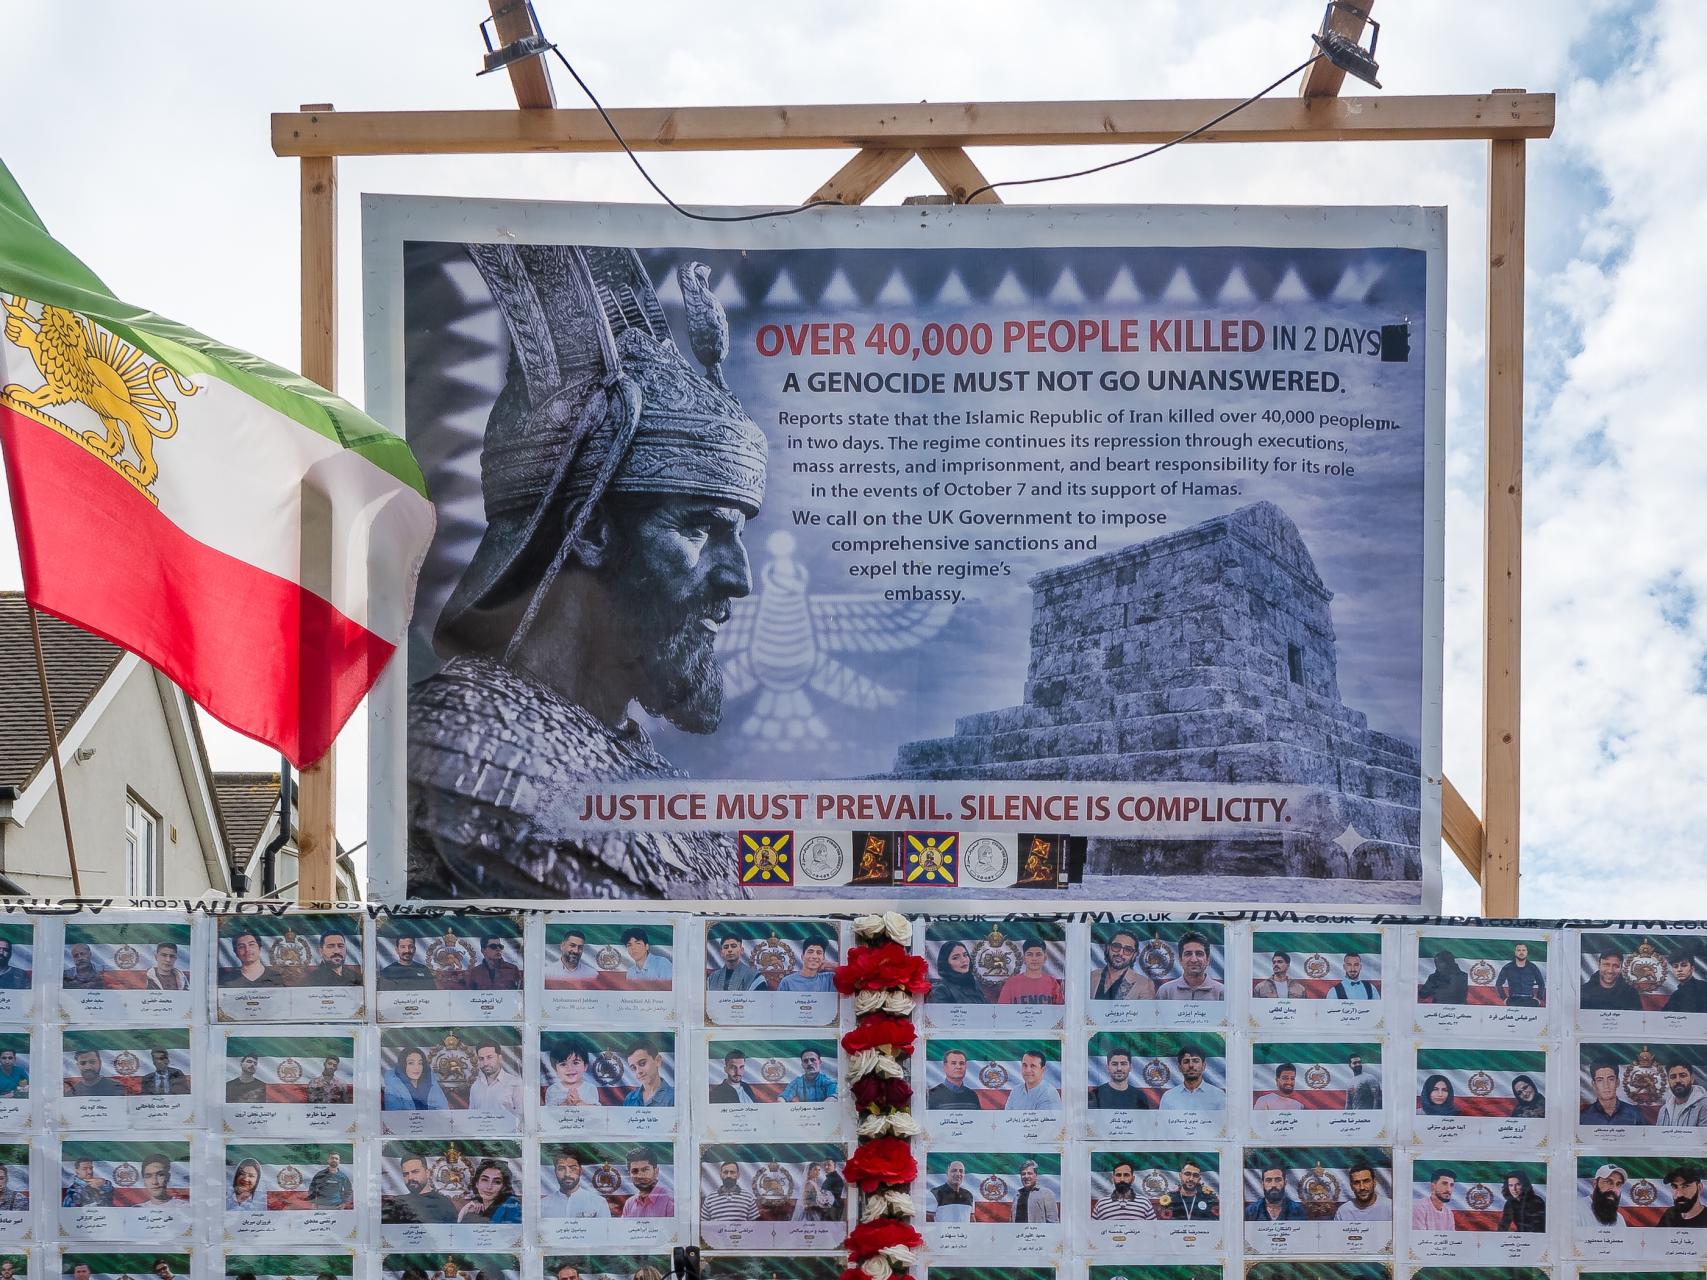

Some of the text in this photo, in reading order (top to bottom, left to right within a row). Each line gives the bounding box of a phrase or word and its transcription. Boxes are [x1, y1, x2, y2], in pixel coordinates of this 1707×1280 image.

[755, 323, 855, 357] OVER
[864, 322, 992, 361] 40,000
[1003, 319, 1140, 353] PEOPLE
[1150, 319, 1265, 353] KILLED
[1272, 325, 1296, 351] IN
[1304, 325, 1316, 352] 2
[782, 370, 1346, 393] A GENOCIDE MUST NOT GO UNANSWERED.
[779, 411, 843, 429] Reports
[848, 413, 889, 426] state
[894, 411, 929, 426] that
[933, 412, 961, 426] the
[966, 409, 1024, 425] Islamic
[1030, 409, 1102, 427] Republic
[1107, 409, 1125, 424] of
[1129, 410, 1162, 423] Iran
[1169, 408, 1214, 423] killed
[1220, 413, 1257, 423] over
[1261, 410, 1314, 425] 40,000
[788, 433, 1348, 454] in two days. The regime continues its repression through executions,
[793, 457, 1354, 476] mass arrests, and imprisonment, and beart responsibility for its role
[811, 481, 1242, 499] in the events of October 7 and its support of Hamas.
[792, 510, 1166, 527] We call on the UK Government to impose
[831, 535, 1097, 554] comprehensive sanctions and
[849, 561, 897, 579] expel
[902, 561, 932, 575] the
[884, 586, 965, 604] embassy.
[579, 794, 1291, 822] JUSTICE MUST PREVAIL. SILENCE IS COMPLICITY.
